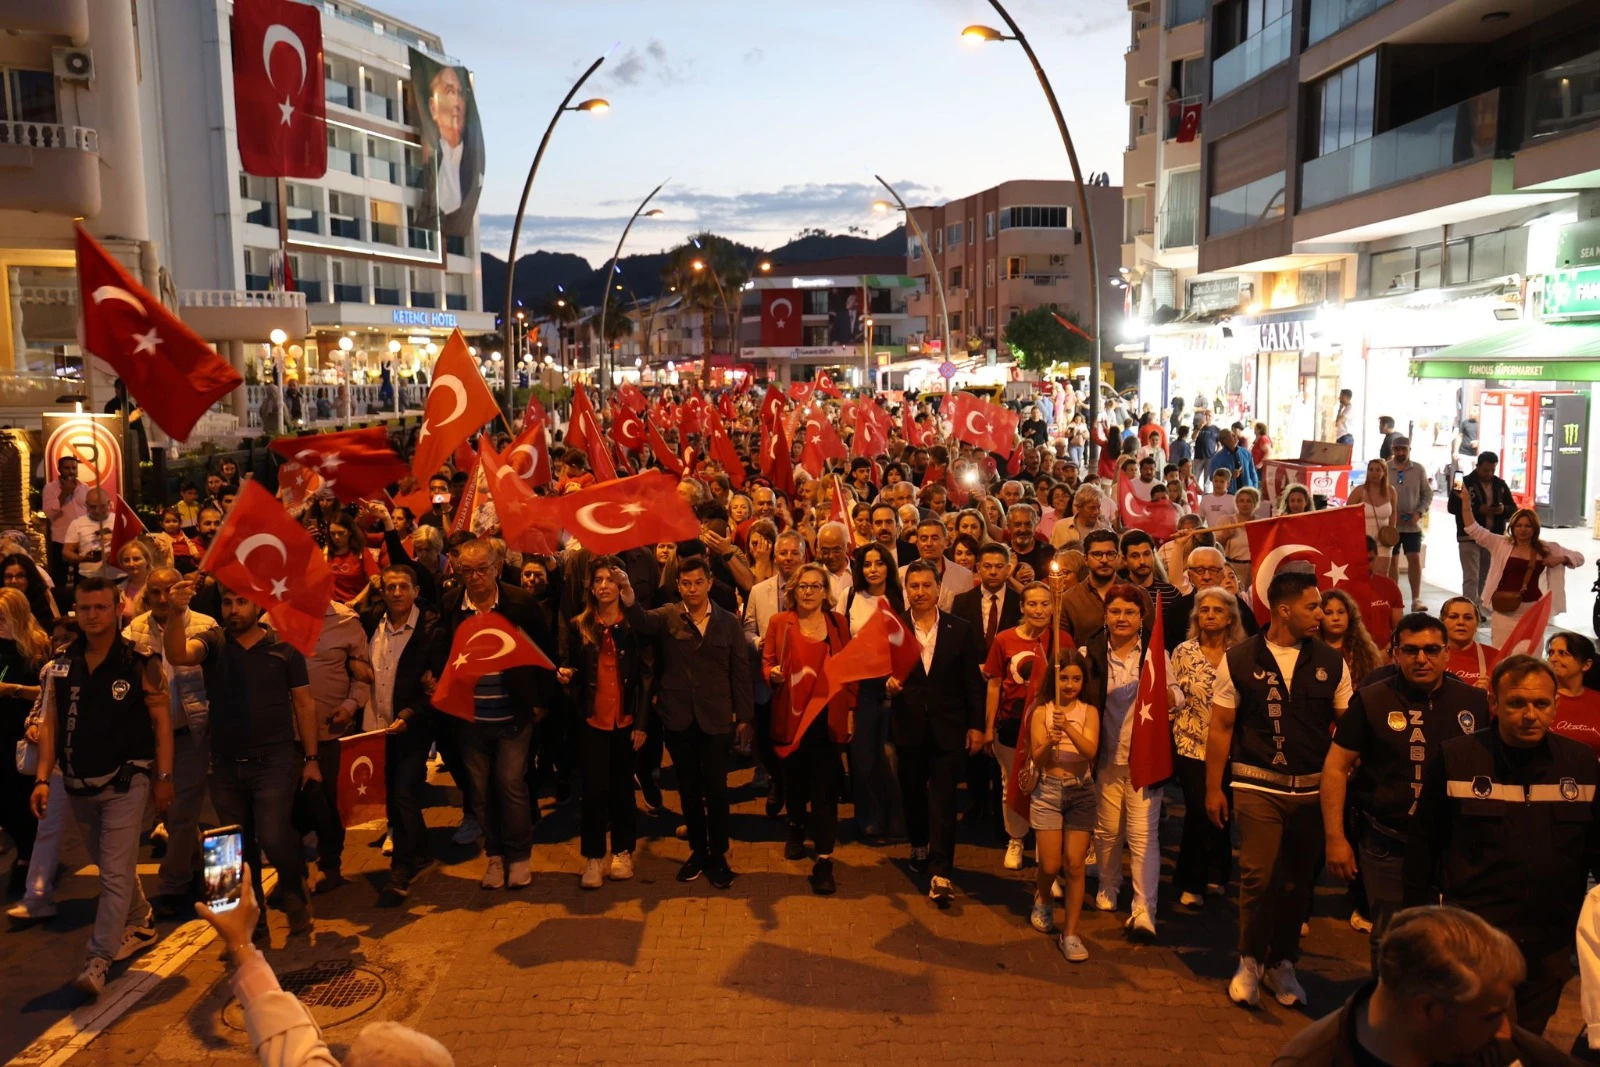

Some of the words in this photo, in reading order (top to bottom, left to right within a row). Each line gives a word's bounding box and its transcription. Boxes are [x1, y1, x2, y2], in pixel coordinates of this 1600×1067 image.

[1580, 247, 1594, 258] SEA
[431, 312, 457, 327] HOTEL
[1469, 365, 1494, 376] FAMOUS
[1494, 362, 1544, 377] SÜPERMARKET
[1266, 671, 1288, 766] ZABITA
[64, 686, 81, 778] ZABITA
